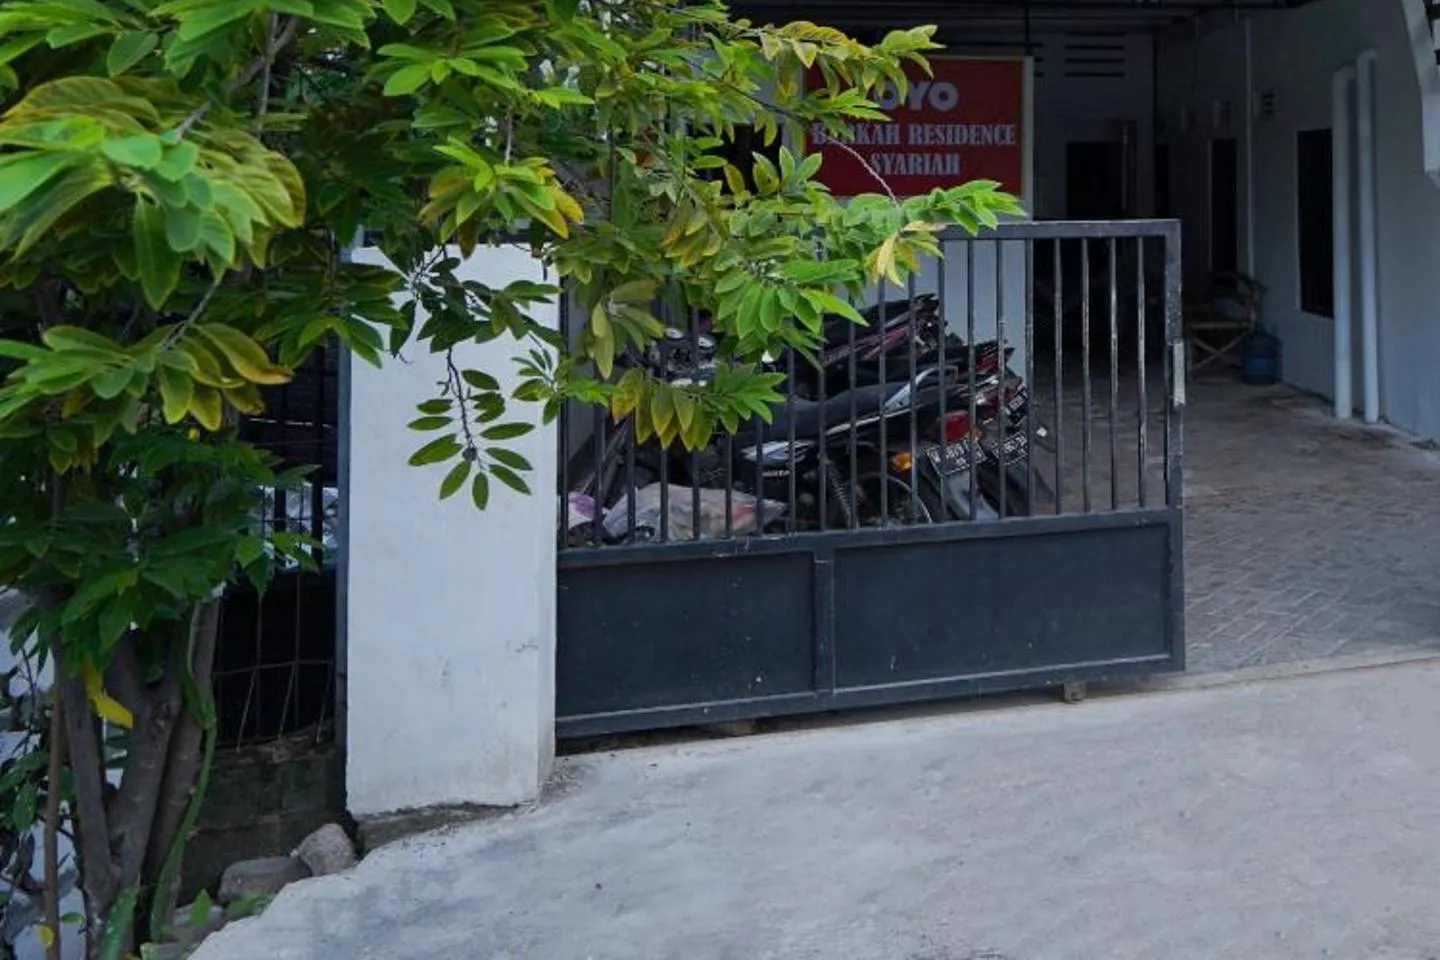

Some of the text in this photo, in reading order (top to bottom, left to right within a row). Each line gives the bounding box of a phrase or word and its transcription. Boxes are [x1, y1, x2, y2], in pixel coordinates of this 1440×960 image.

[811, 122, 1016, 145] BKAH RESIDENCE
[871, 153, 960, 176] SYARIAH
